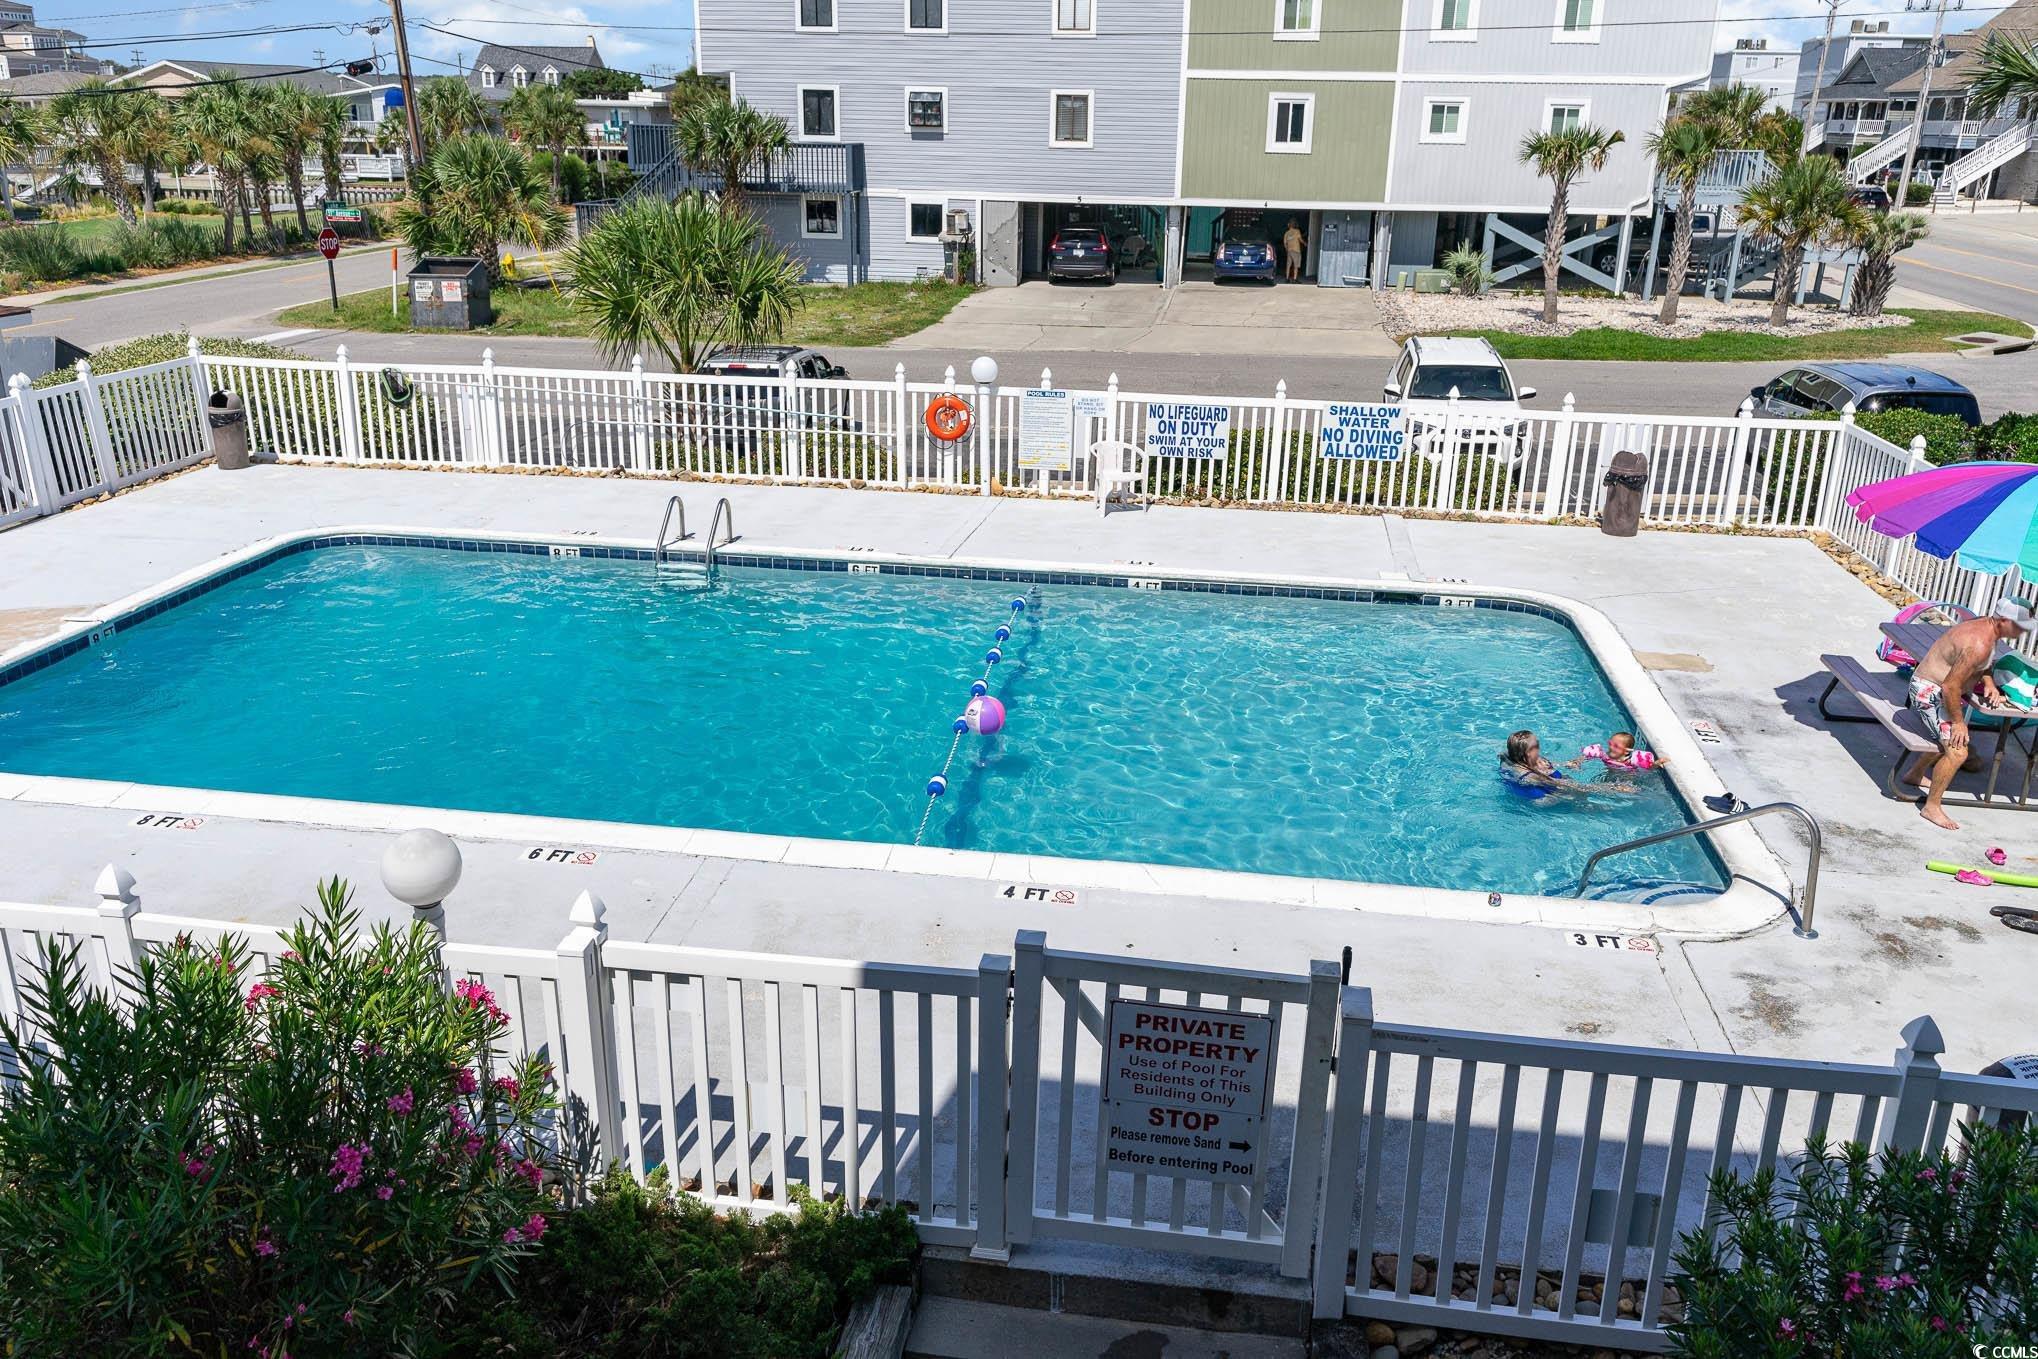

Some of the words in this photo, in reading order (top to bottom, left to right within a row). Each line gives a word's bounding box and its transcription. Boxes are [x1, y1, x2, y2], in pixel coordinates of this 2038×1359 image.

[321, 237, 338, 250] STOP
[1149, 404, 1165, 419] NO
[1168, 405, 1228, 422] LIFEGUARD
[1329, 405, 1401, 418] SHALLOW
[1158, 419, 1177, 435] ON
[1181, 420, 1217, 436] DUTY
[1338, 416, 1390, 429] WATER
[1148, 435, 1176, 446] SWIM
[1179, 436, 1193, 447] AT
[1196, 437, 1226, 448] YOUR
[1322, 427, 1344, 442] NO
[1349, 428, 1404, 445] DIVING
[1159, 445, 1184, 457] OWN
[1187, 447, 1213, 458] RISK
[1324, 443, 1399, 460] ALLOWED
[565, 548, 578, 557] FT
[865, 565, 878, 573] FT
[1444, 599, 1453, 607] 3
[1458, 599, 1473, 608] FT
[136, 814, 155, 825] 8
[152, 816, 185, 828] FT
[528, 847, 544, 860] 6
[545, 849, 575, 863] FT
[1003, 885, 1016, 898] 4
[1024, 887, 1050, 901] FT
[1573, 933, 1588, 946] 3
[1594, 934, 1621, 949] FT
[1135, 1013, 1246, 1041] PRIVATE
[1118, 1033, 1261, 1063] PROPERTY
[1129, 1054, 1157, 1068] Use
[1162, 1059, 1178, 1070] of
[1181, 1060, 1215, 1075] Pool
[1220, 1065, 1246, 1078] For
[1120, 1068, 1195, 1086] Residents
[1200, 1077, 1216, 1089] of
[1220, 1079, 1251, 1093] This
[1134, 1083, 1196, 1103] Building
[1200, 1091, 1236, 1108] Only
[1148, 1107, 1220, 1132] STOP
[1110, 1126, 1147, 1142] Please
[1150, 1133, 1191, 1146] remove
[1193, 1135, 1221, 1150] Sand
[1108, 1147, 1155, 1164] Before
[1159, 1155, 1218, 1175] entering
[1222, 1160, 1253, 1176] Pool
